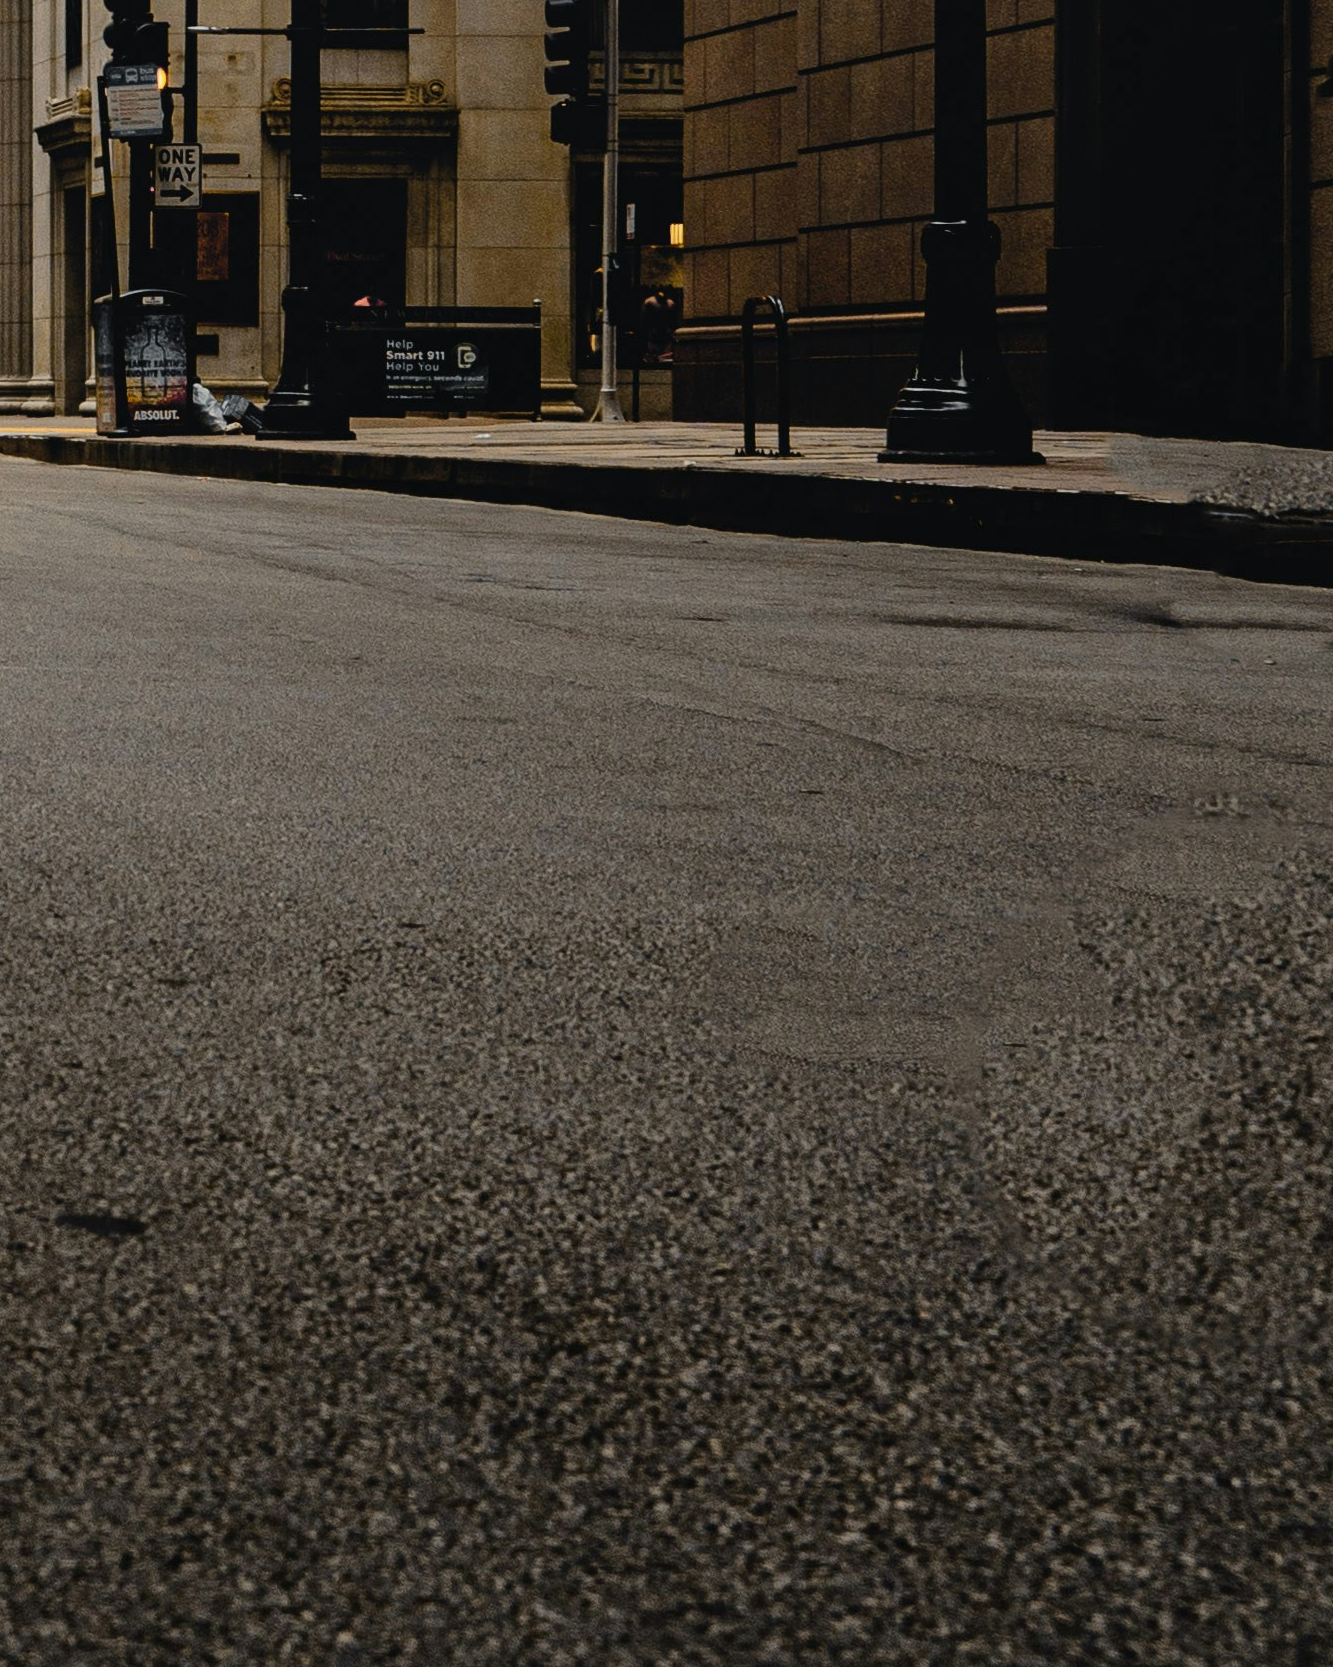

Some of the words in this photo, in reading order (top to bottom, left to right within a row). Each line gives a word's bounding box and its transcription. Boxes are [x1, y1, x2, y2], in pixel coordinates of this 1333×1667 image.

[140, 67, 155, 75] bus
[158, 148, 195, 165] ONE
[158, 167, 196, 182] WAY
[386, 339, 414, 351] Help
[385, 351, 424, 360] Smart
[427, 351, 445, 360] 911
[386, 361, 414, 373] Help
[418, 361, 440, 372] You
[134, 409, 180, 421] ABSOLUT.
